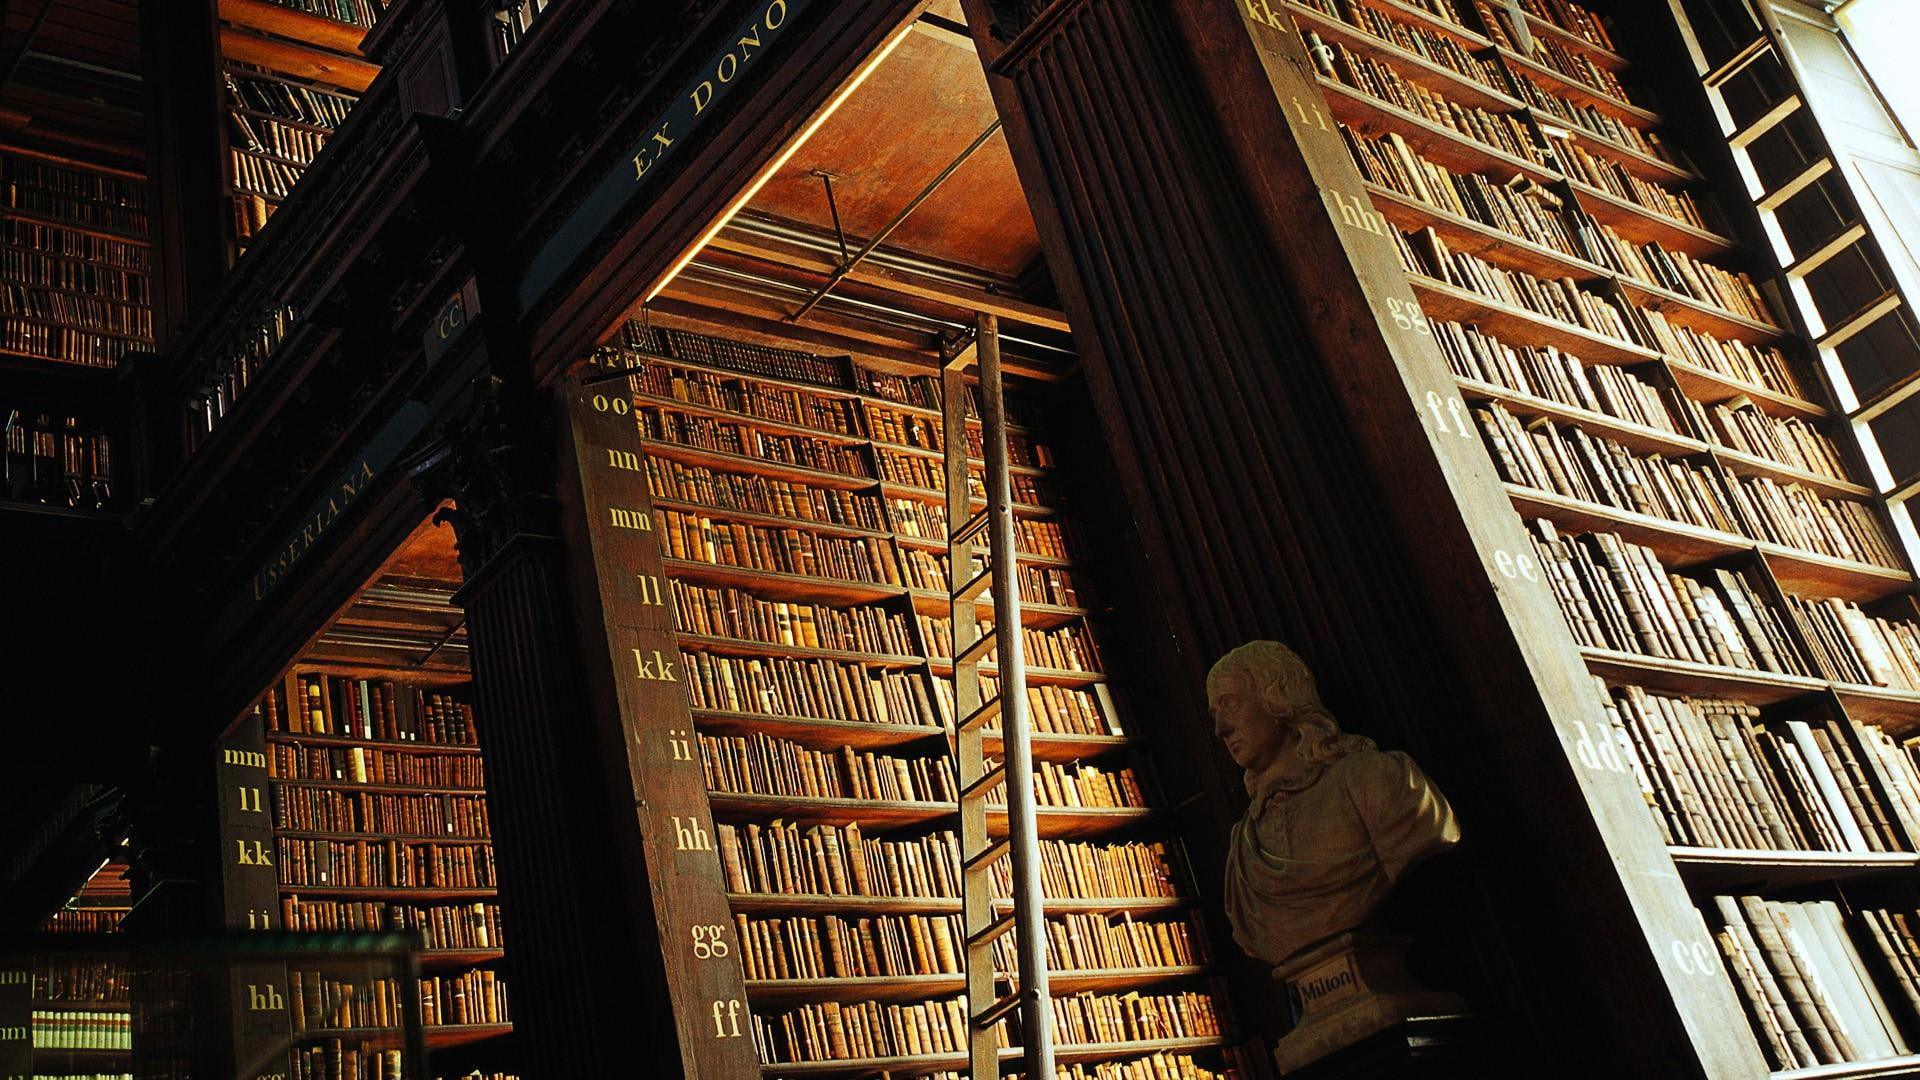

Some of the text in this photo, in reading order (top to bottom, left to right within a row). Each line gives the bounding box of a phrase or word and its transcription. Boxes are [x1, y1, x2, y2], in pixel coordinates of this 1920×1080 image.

[632, 0, 787, 181] EX DONO
[1293, 97, 1330, 132] ii
[1330, 189, 1384, 237] hh
[1386, 296, 1431, 335] gg
[592, 394, 628, 416] oo
[1426, 390, 1472, 439] ff
[607, 448, 640, 471] nn
[252, 461, 375, 601] USSERIANA
[609, 507, 653, 531] mm
[1494, 549, 1538, 583] ee
[637, 574, 664, 606] ll
[632, 648, 677, 682] kk
[224, 748, 266, 769] mm
[669, 729, 693, 760] ii
[1573, 720, 1626, 773] dd
[239, 786, 264, 813] ll
[672, 816, 712, 850] hh
[236, 839, 273, 867] kk
[247, 908, 271, 931] ii
[691, 924, 729, 959] gg
[1672, 939, 1716, 977] cc
[248, 984, 285, 1010] hh
[1301, 971, 1351, 1005] Milton
[712, 1000, 742, 1038] ff
